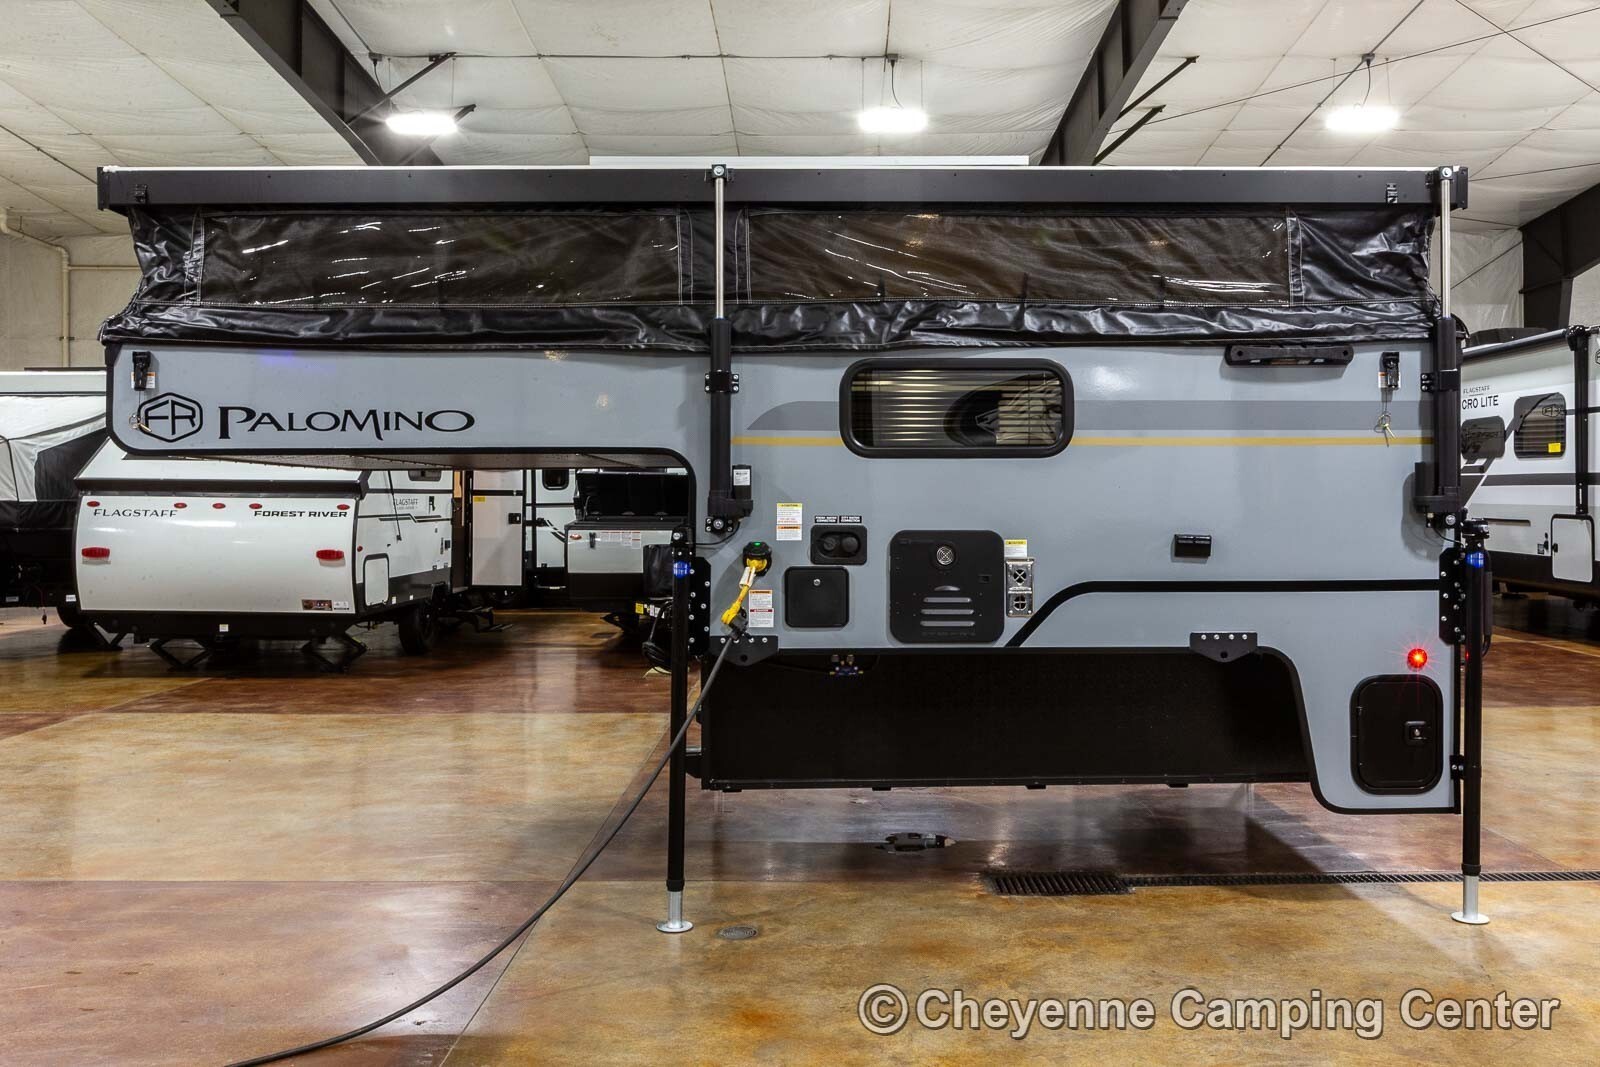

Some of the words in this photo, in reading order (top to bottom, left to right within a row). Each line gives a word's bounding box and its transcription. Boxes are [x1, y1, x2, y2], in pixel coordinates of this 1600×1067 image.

[1481, 395, 1499, 407] LITE
[218, 406, 476, 441] PALOMINO
[394, 498, 418, 506] LAGSTAFF
[93, 508, 178, 518] FLAGSTAFF
